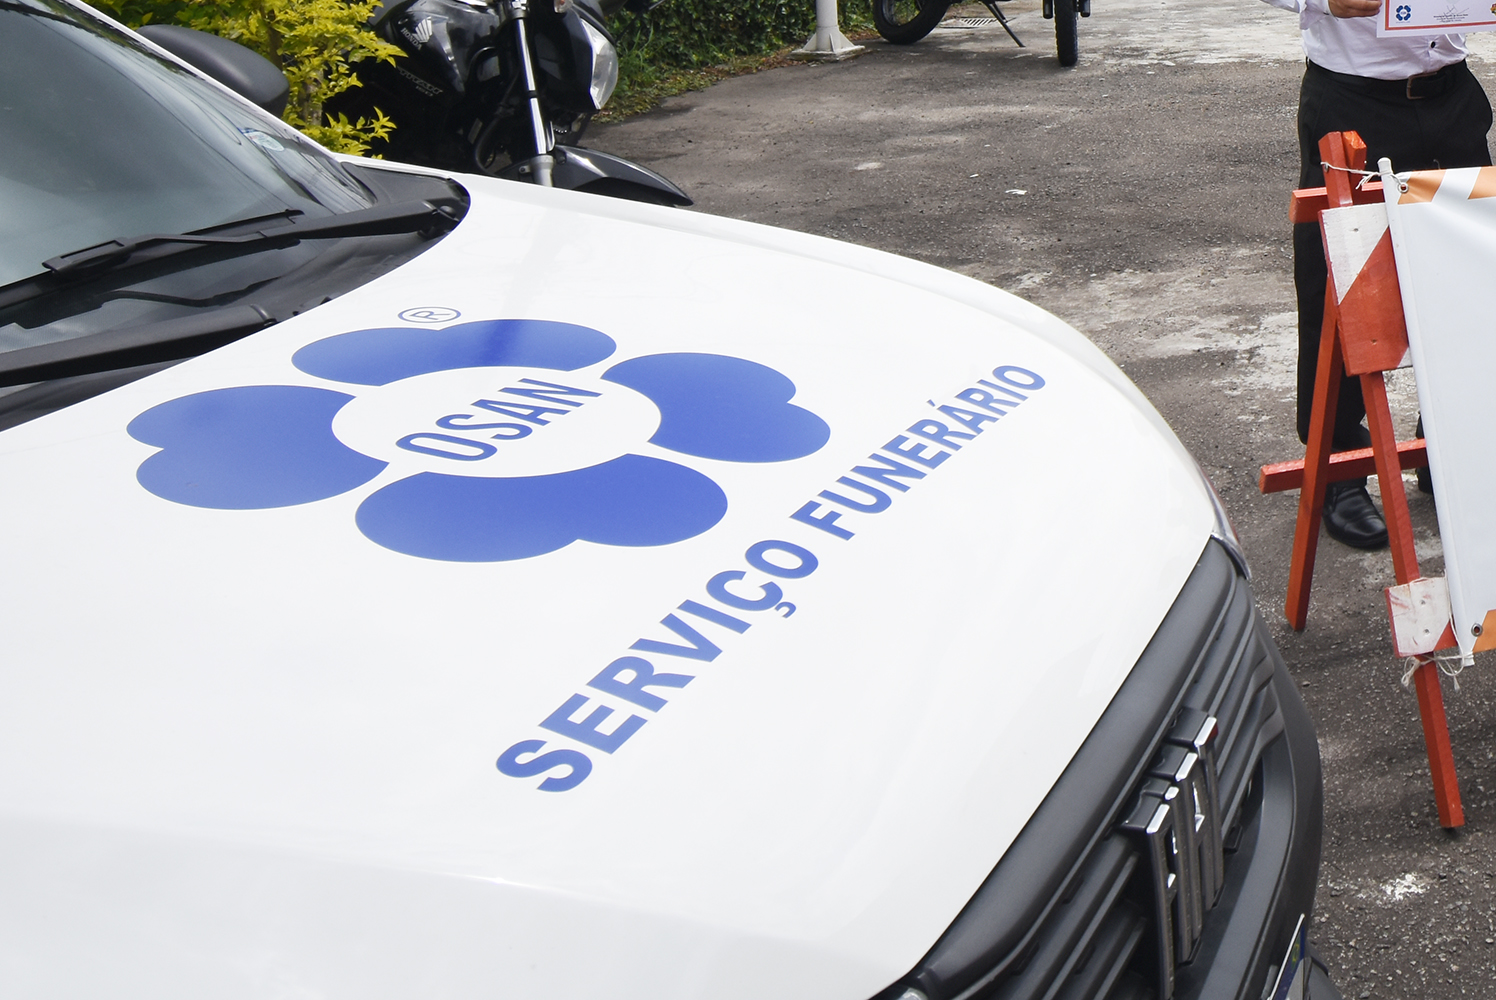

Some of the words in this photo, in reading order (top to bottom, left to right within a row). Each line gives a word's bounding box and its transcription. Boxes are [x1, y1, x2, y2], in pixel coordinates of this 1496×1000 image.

[400, 27, 423, 50] HONDA
[395, 378, 603, 462] OSAN
[495, 539, 819, 793] SERVIÇO
[789, 364, 1046, 541] FUNERÁRIO
